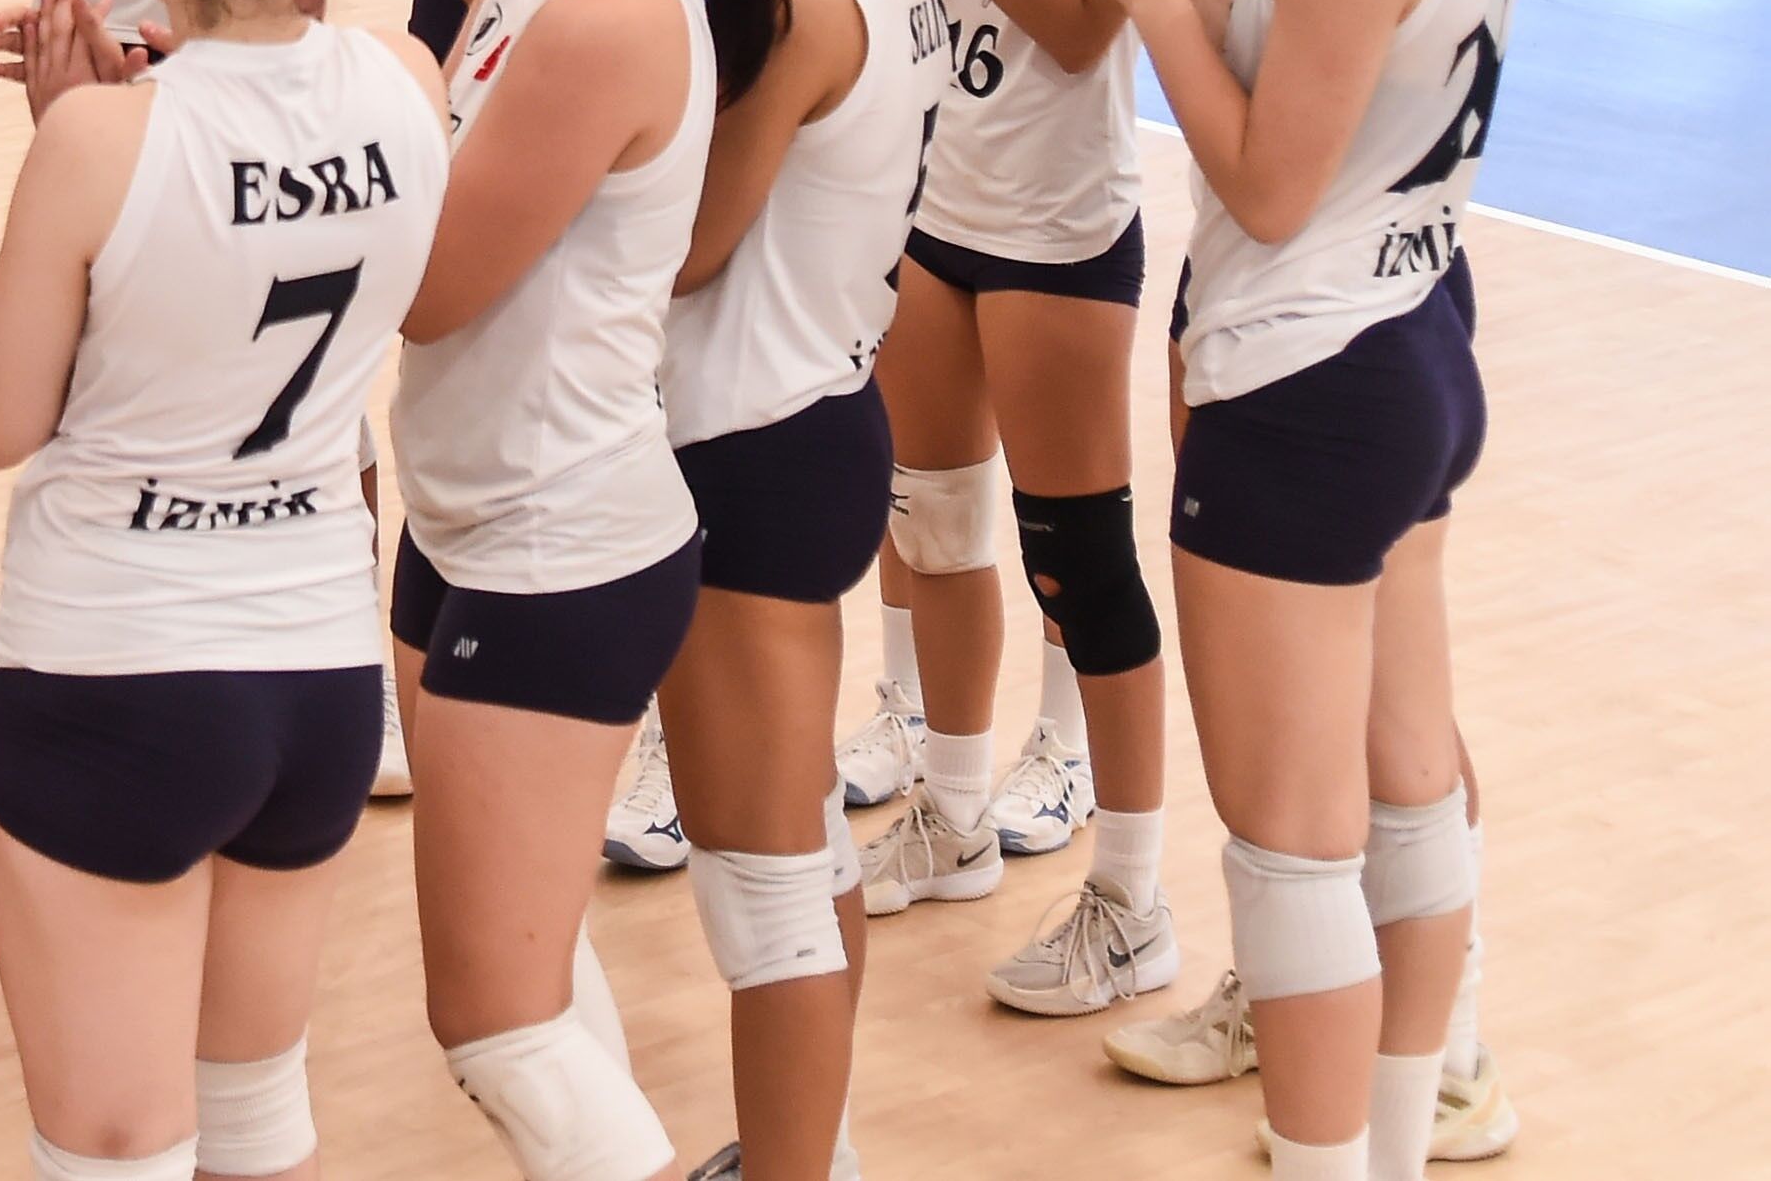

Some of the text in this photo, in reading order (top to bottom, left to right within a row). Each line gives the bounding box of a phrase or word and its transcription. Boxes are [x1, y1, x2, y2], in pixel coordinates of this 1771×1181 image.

[230, 141, 400, 227] ESRA
[1372, 205, 1457, 277] İZMİ
[232, 257, 365, 461] 7
